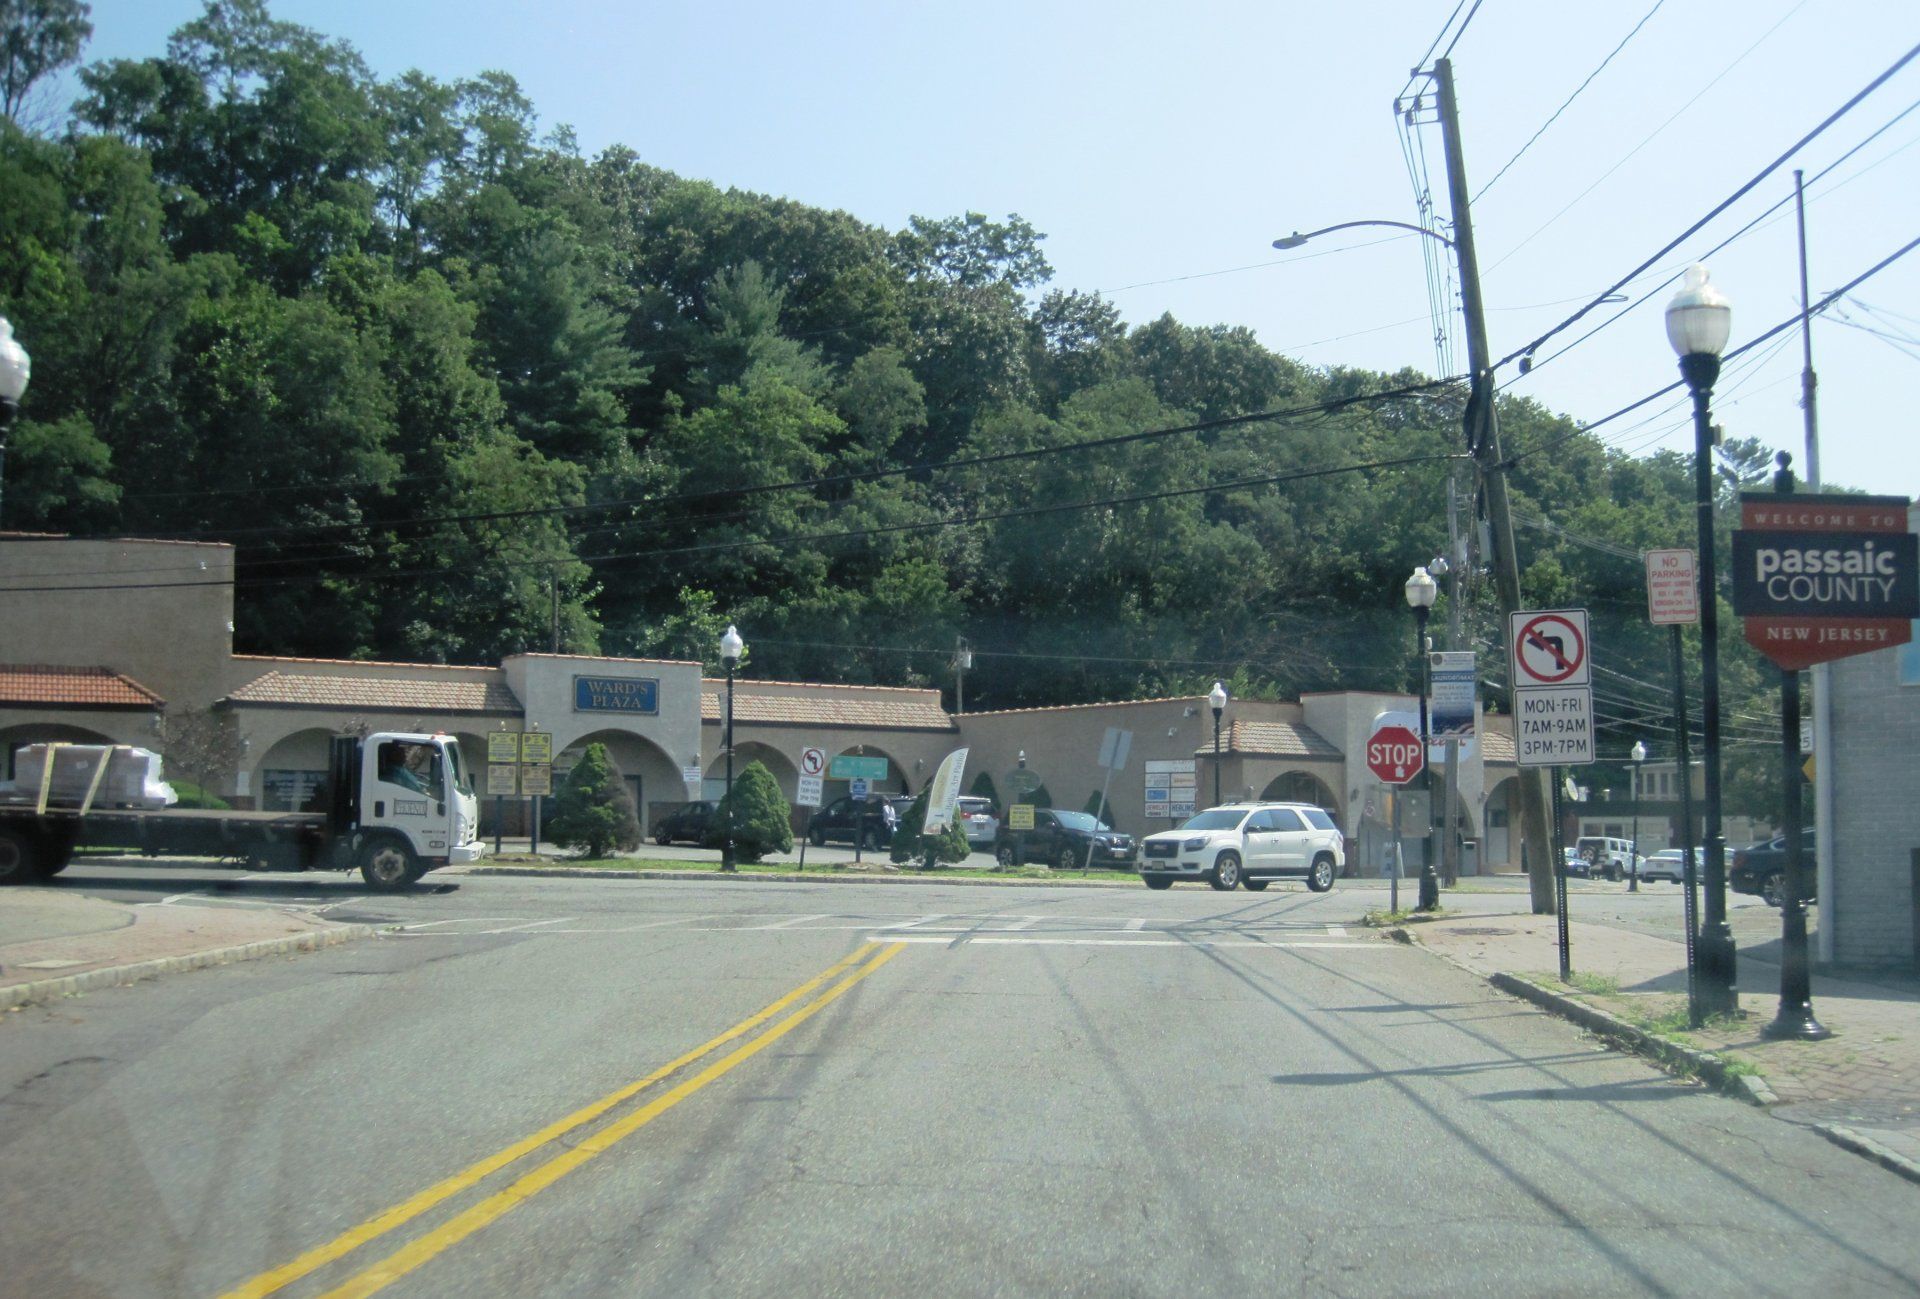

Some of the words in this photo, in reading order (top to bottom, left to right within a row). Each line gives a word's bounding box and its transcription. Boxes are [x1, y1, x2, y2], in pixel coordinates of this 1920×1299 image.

[1754, 513, 1856, 526] WELCOME
[1869, 515, 1895, 527] TO
[1662, 557, 1679, 568] NO
[1756, 540, 1896, 583] passaic
[1651, 569, 1691, 578] PARKING
[1767, 575, 1896, 602] COUNTY
[1767, 627, 1811, 640] NEW
[1817, 628, 1888, 644] JERSEY
[586, 680, 649, 695] WARD'S
[591, 695, 642, 708] PLAZA
[1524, 698, 1582, 714] MON-FRI
[1523, 718, 1586, 735] 7AM-9AM
[1370, 743, 1420, 765] STOP
[1524, 739, 1587, 755] 3PM-7PM
